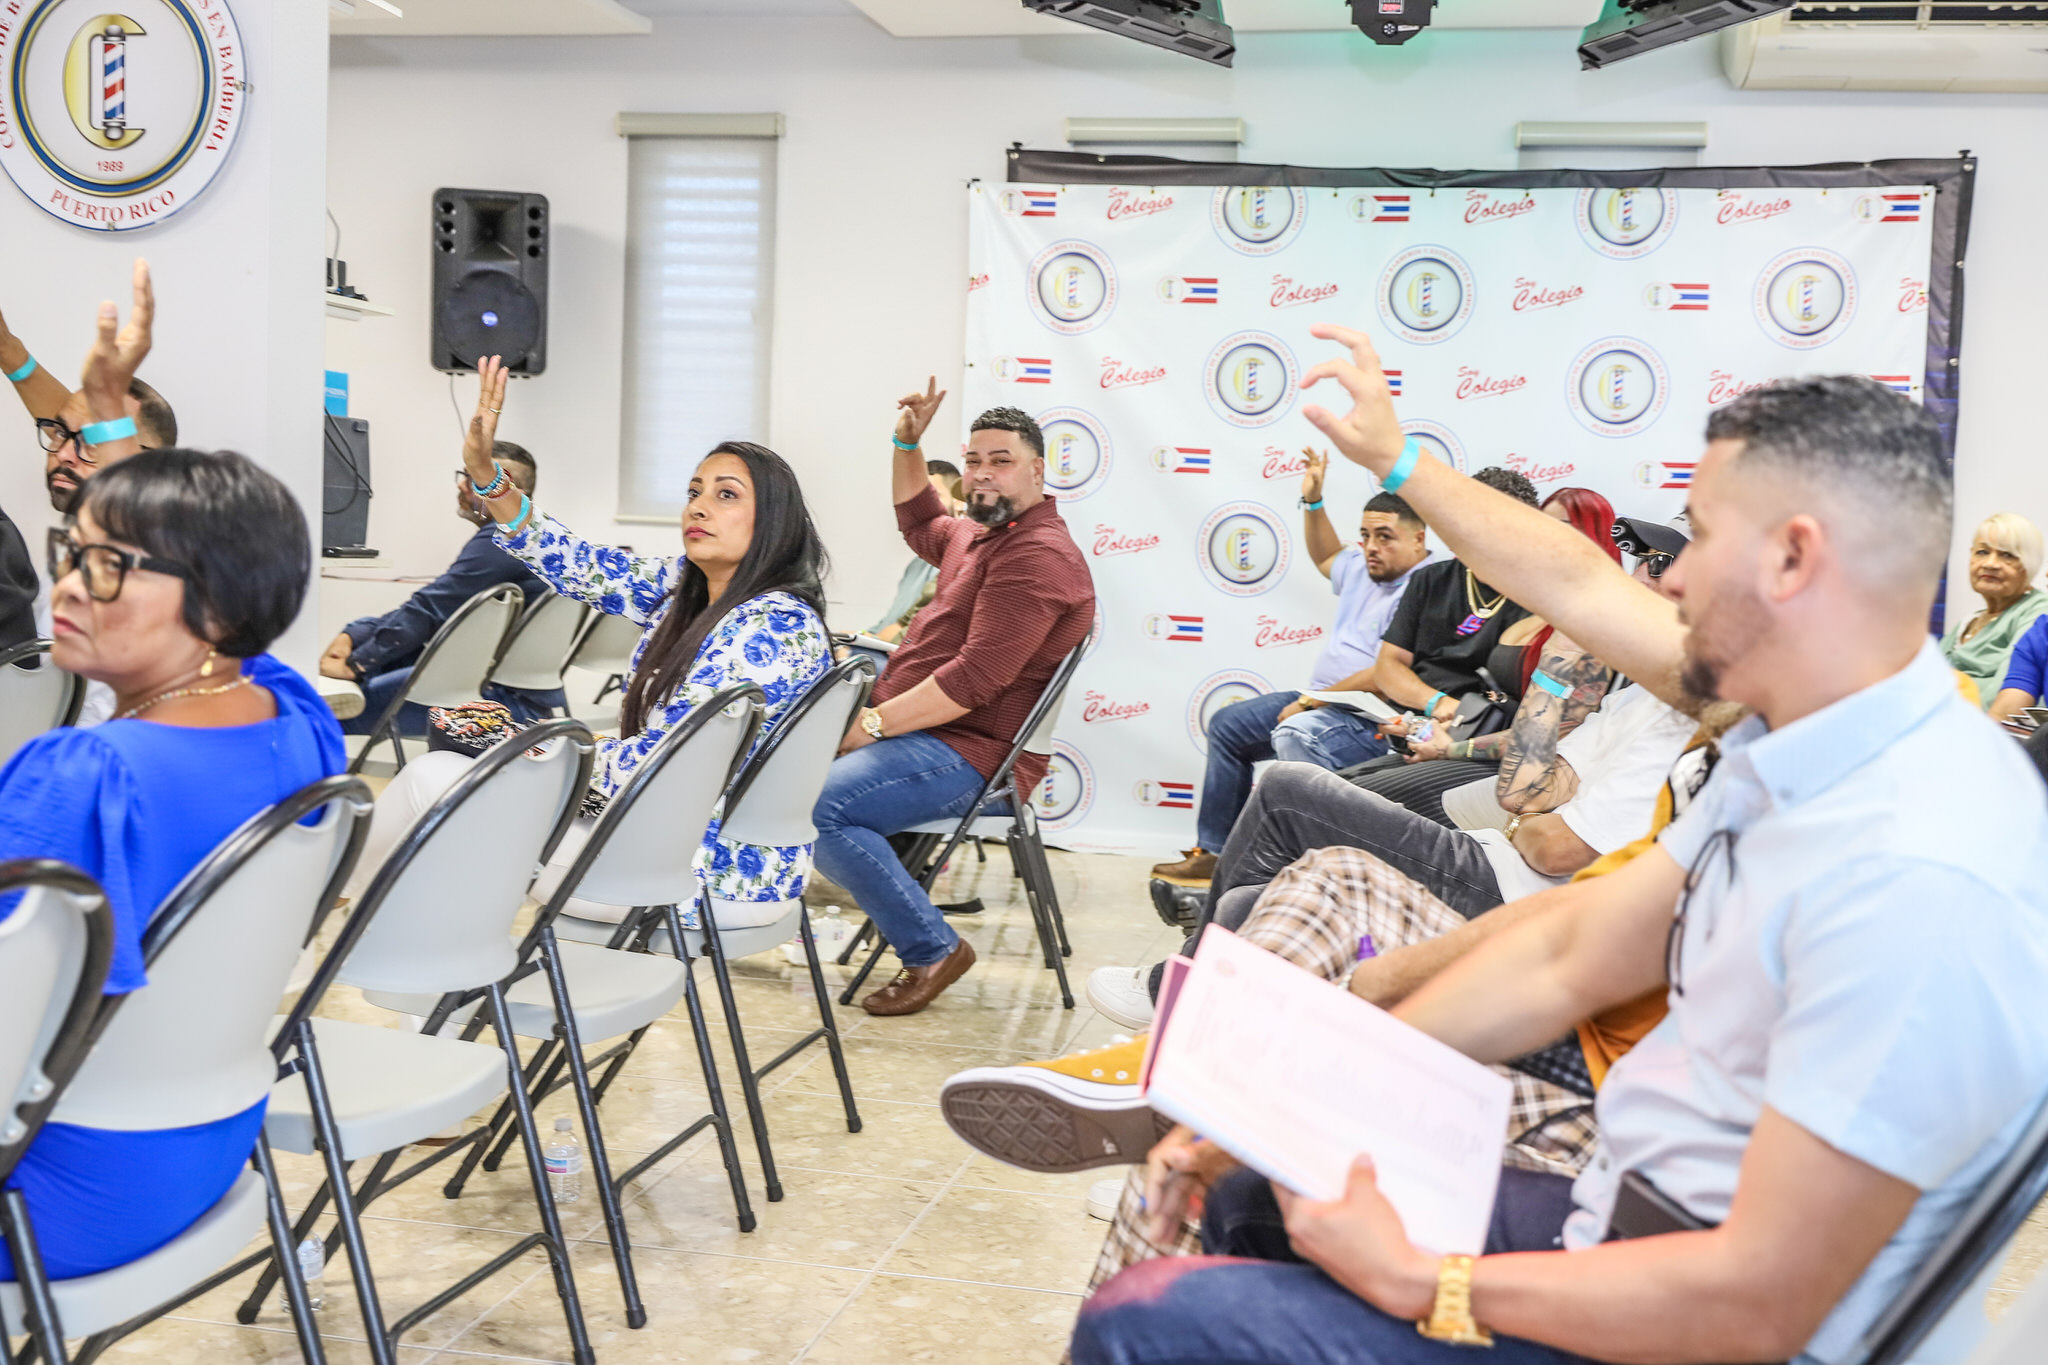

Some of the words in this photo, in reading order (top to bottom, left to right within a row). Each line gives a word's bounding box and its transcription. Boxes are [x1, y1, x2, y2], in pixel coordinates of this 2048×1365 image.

[207, 11, 229, 39] EN
[96, 160, 125, 172] 1989
[1108, 186, 1129, 199] Soy
[1466, 189, 1488, 201] Soy
[1719, 189, 1742, 201] Soy
[50, 188, 124, 222] PUERTO
[129, 189, 176, 220] RICO
[1106, 194, 1174, 222] Colegio
[1464, 194, 1535, 224] Colegio
[1717, 195, 1792, 224] Colegio
[1273, 275, 1293, 286] Soy
[1514, 277, 1536, 288] Soy
[1899, 277, 1924, 289] Soy
[1270, 281, 1339, 307] Colegio
[1513, 282, 1584, 311] Colegio
[1102, 356, 1122, 368] Soy
[1100, 363, 1167, 389] Colegio
[1458, 366, 1479, 378] Soy
[1709, 369, 1733, 382] Soy
[1456, 373, 1528, 399] Colegio
[1708, 378, 1779, 404] Cole
[1264, 446, 1285, 457] Soy
[1505, 452, 1528, 465] Soy
[1094, 523, 1116, 535] Soy
[1093, 531, 1160, 556] Colegio
[1257, 614, 1277, 627] Soy
[1255, 622, 1324, 648] Colegio
[1084, 689, 1106, 701] Soy
[1083, 698, 1150, 723] Colegio
